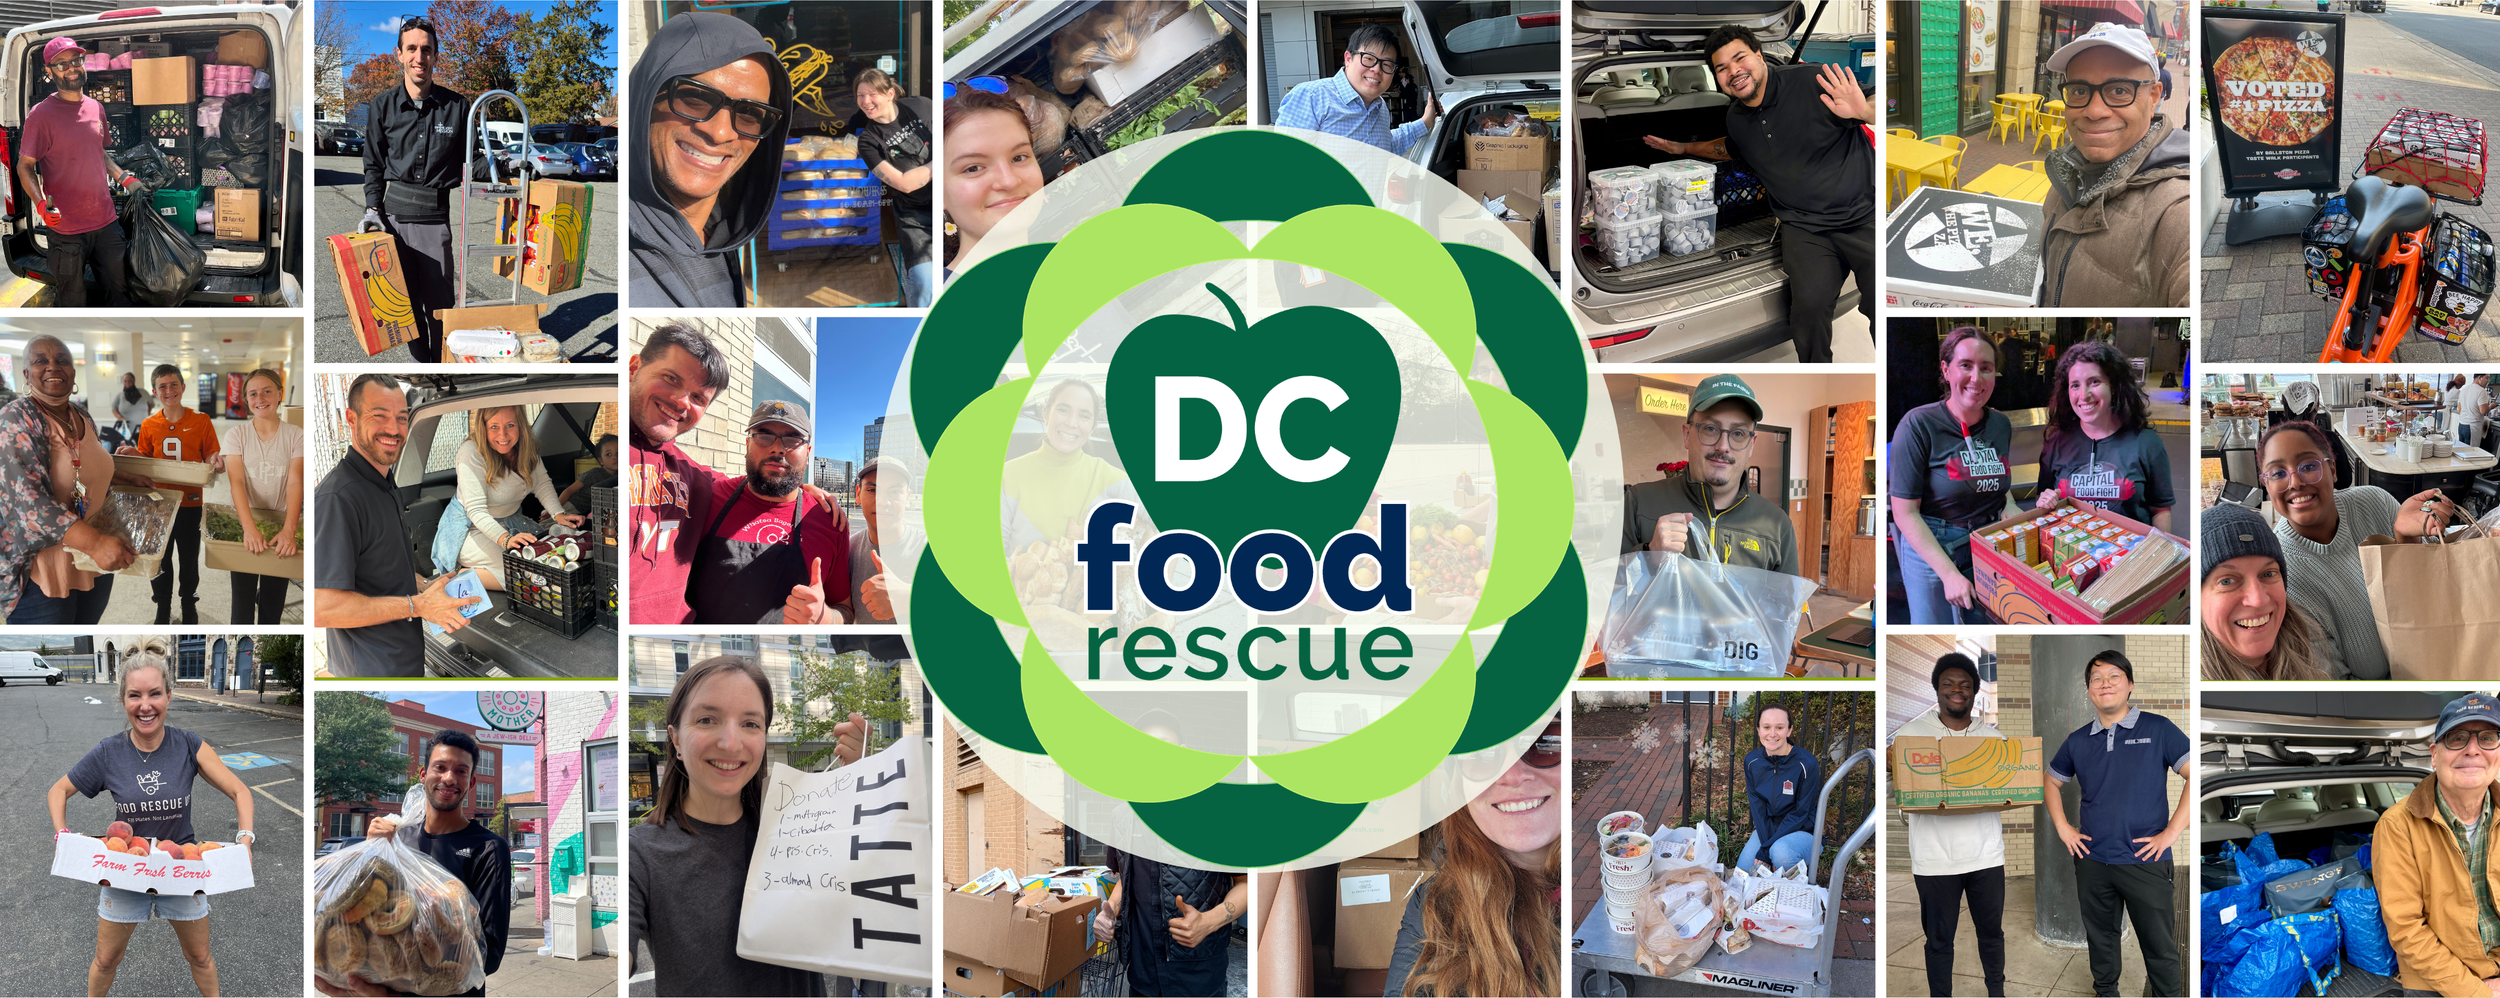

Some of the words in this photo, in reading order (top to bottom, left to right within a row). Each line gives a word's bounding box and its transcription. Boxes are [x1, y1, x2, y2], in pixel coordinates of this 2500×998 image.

[2225, 80, 2326, 97] VOTED
[2229, 100, 2254, 112] #1
[2257, 100, 2326, 112] PIZZA
[846, 185, 888, 197] HOURS
[376, 249, 390, 271] Dole
[556, 264, 565, 284] Dole
[2461, 294, 2481, 305] HAPPY
[385, 322, 397, 347] BANANAS
[392, 319, 403, 344] PREMIUM
[1644, 393, 1669, 409] Order
[1670, 397, 1688, 412] Here
[2366, 409, 2374, 428] ATTE
[162, 437, 182, 461] 9
[1961, 449, 1999, 466] CITAL
[1971, 465, 1988, 476] FOOD
[1988, 463, 2005, 474] FIGHT
[1976, 478, 2000, 493] 2025
[2072, 472, 2114, 487] CAPITAL
[2076, 487, 2095, 497] FOOD
[2096, 487, 2119, 497] FIGHT
[742, 517, 772, 532] Whatsa
[1975, 565, 1997, 589] BANANAS
[1975, 574, 1998, 598] PREMIUM
[458, 583, 470, 599] La
[1724, 640, 1759, 660] DIG
[487, 708, 536, 727] MOTHER
[1912, 752, 1942, 765] Dole
[1997, 763, 2041, 773] ORGANIC
[773, 772, 854, 812] Donate
[1905, 791, 1935, 800] CERTIFIED
[1935, 790, 1961, 799] ORGANIC
[1961, 789, 1989, 797] BANANAS
[140, 797, 183, 812] RESCUE
[92, 854, 128, 872] Farm
[849, 758, 922, 950] TATTE
[2275, 866, 2343, 893] SWING'S
[1712, 974, 1796, 994] MAGLINER
